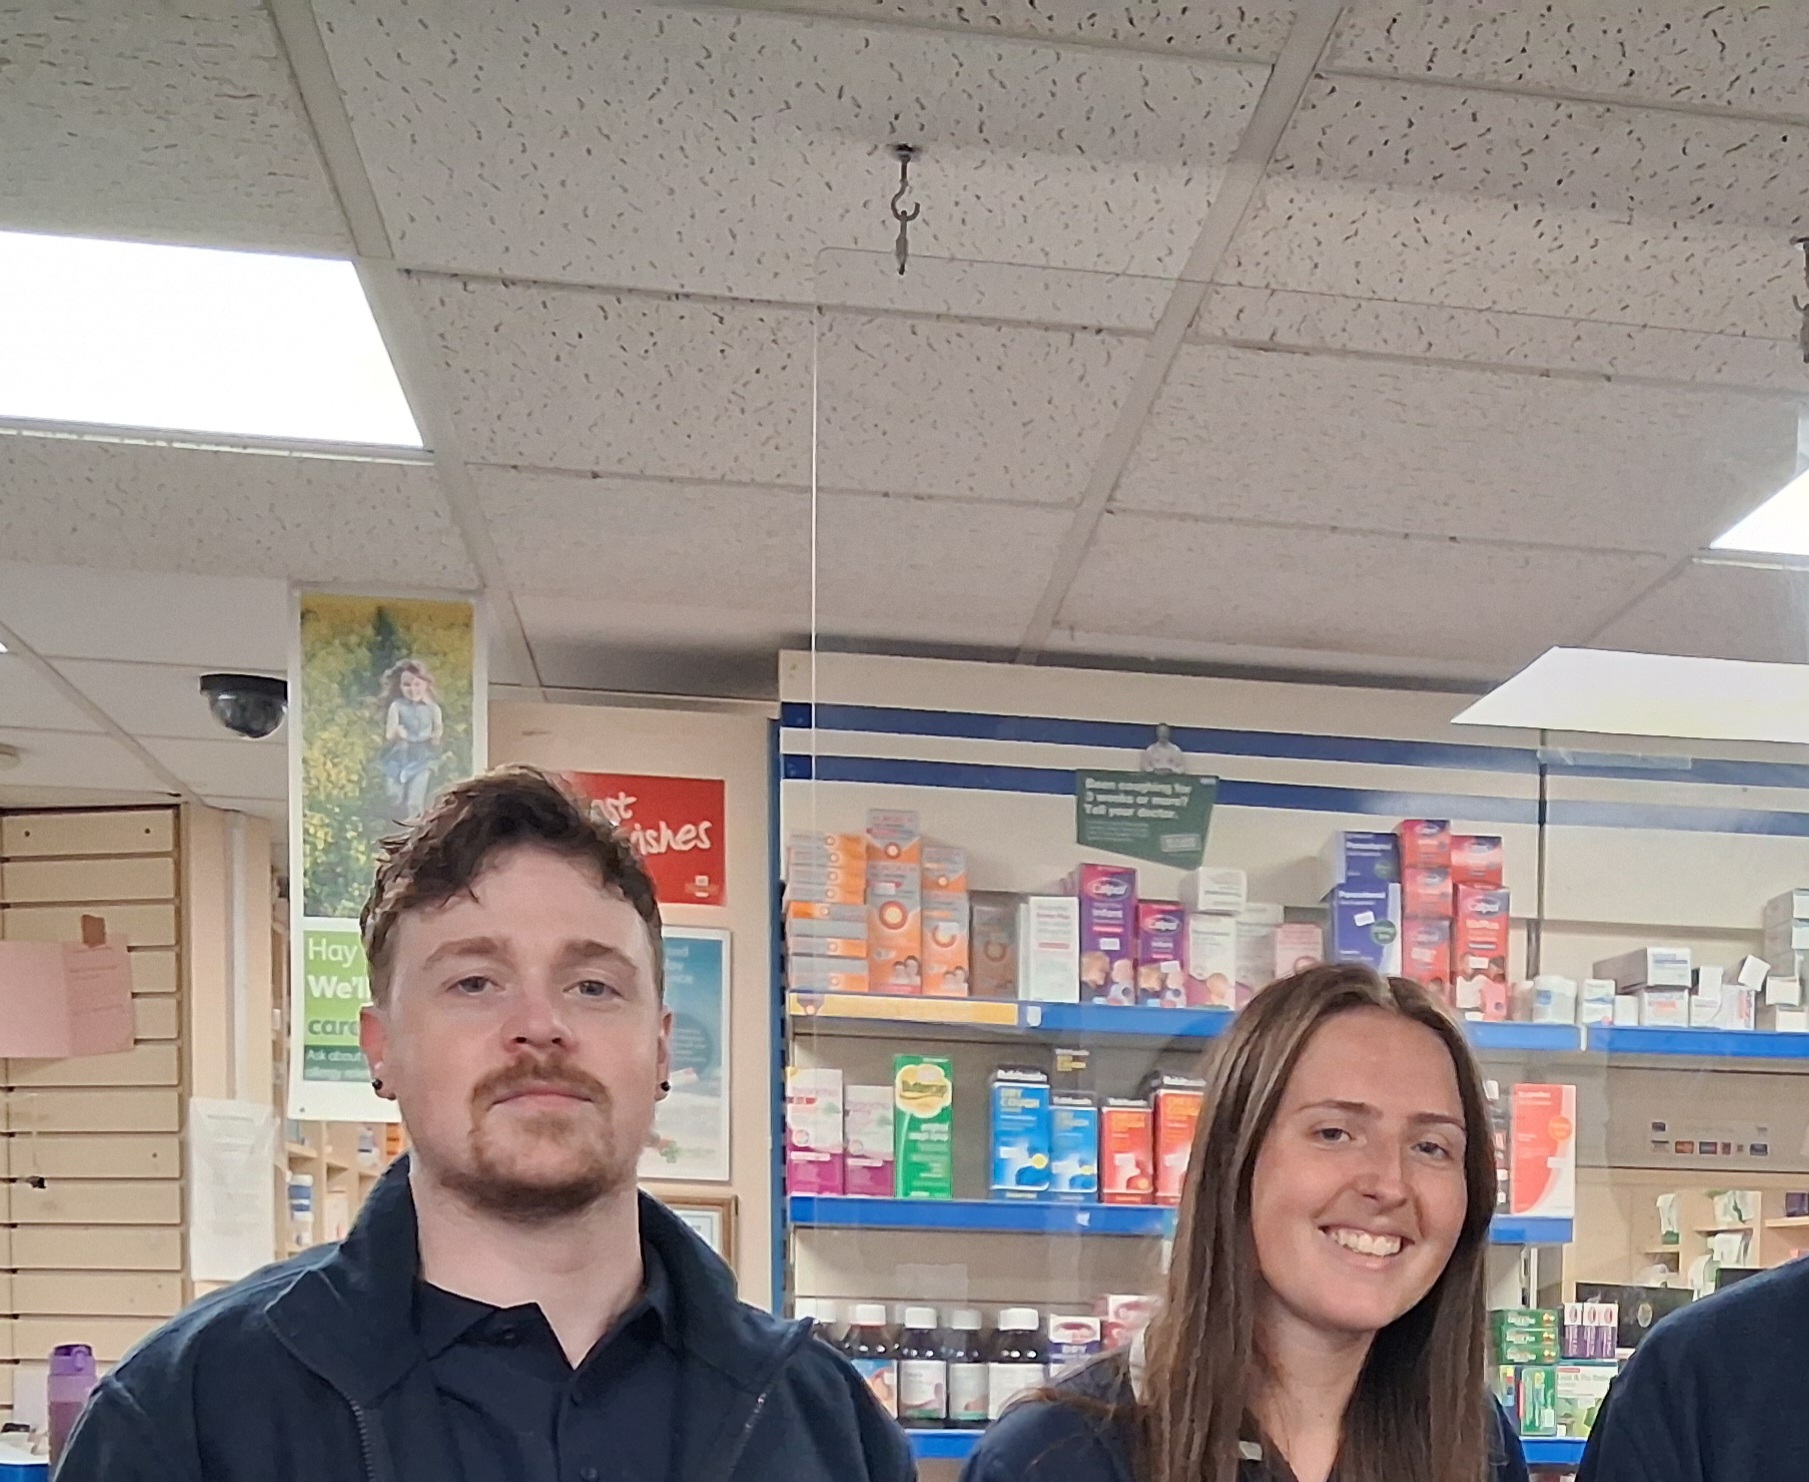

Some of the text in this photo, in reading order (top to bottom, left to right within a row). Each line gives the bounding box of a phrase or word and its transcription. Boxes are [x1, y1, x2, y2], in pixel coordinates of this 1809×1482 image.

[630, 820, 713, 856] ishes
[308, 937, 358, 968] Hay
[307, 1049, 326, 1061] Ask
